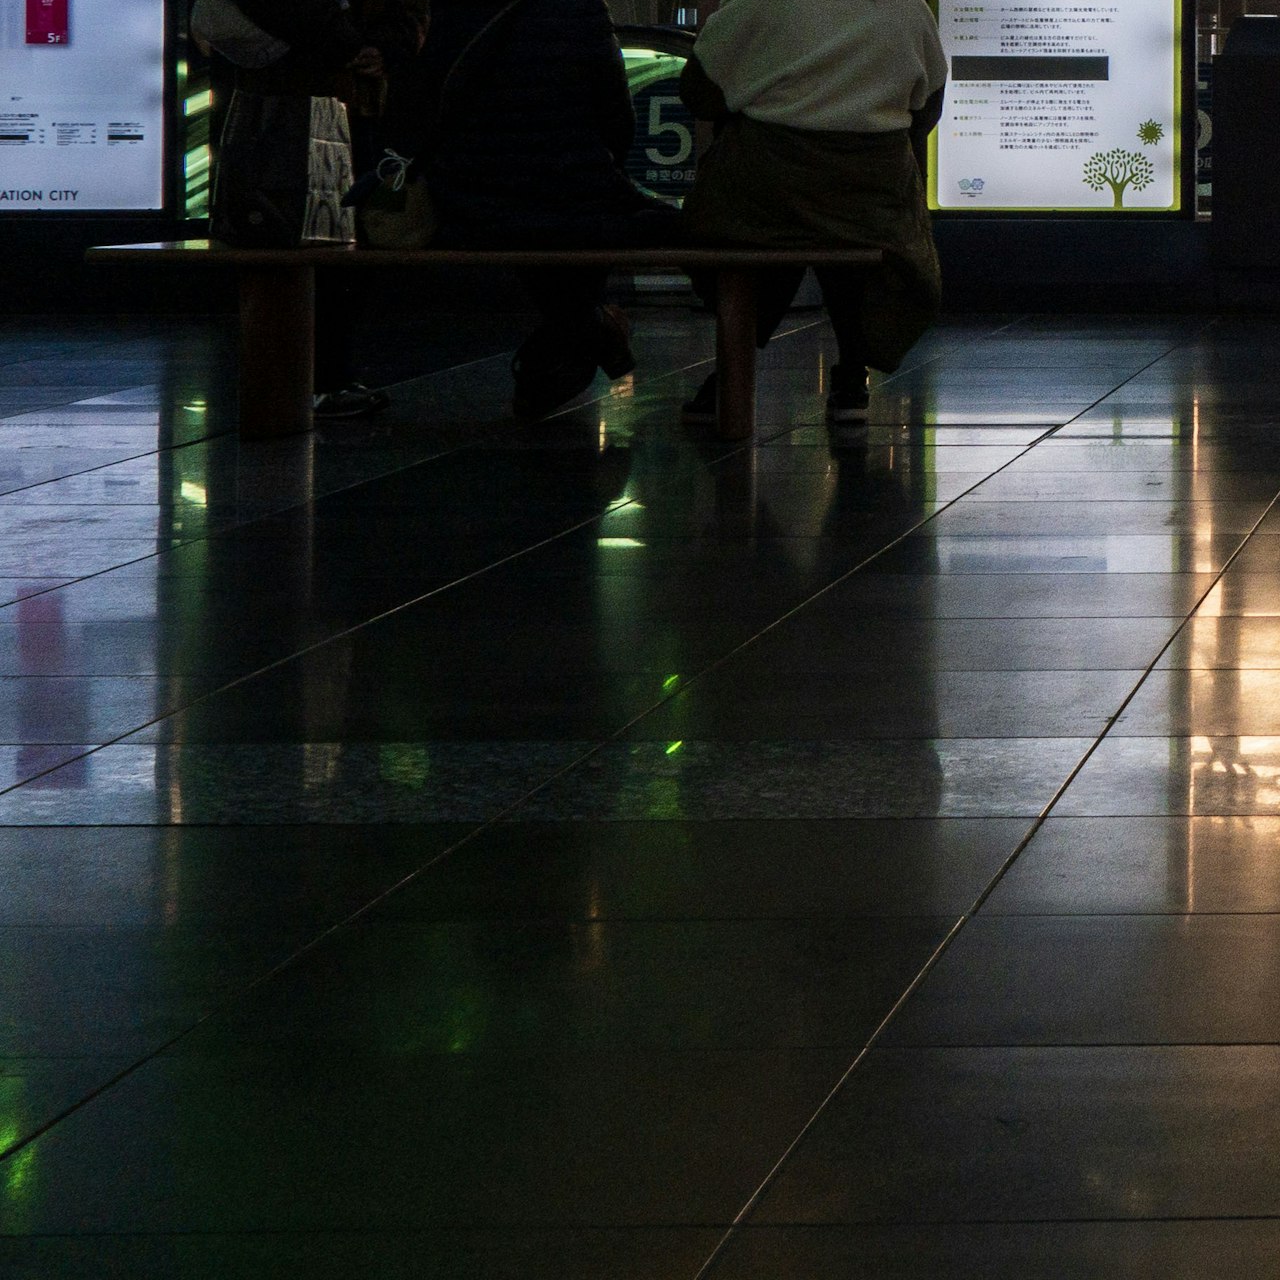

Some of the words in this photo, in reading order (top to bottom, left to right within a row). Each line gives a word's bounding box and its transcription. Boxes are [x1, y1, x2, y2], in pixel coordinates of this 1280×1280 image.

[47, 32, 60, 44] 5F
[645, 96, 692, 166] 5
[0, 190, 43, 201] ATION
[49, 190, 79, 201] CITY
